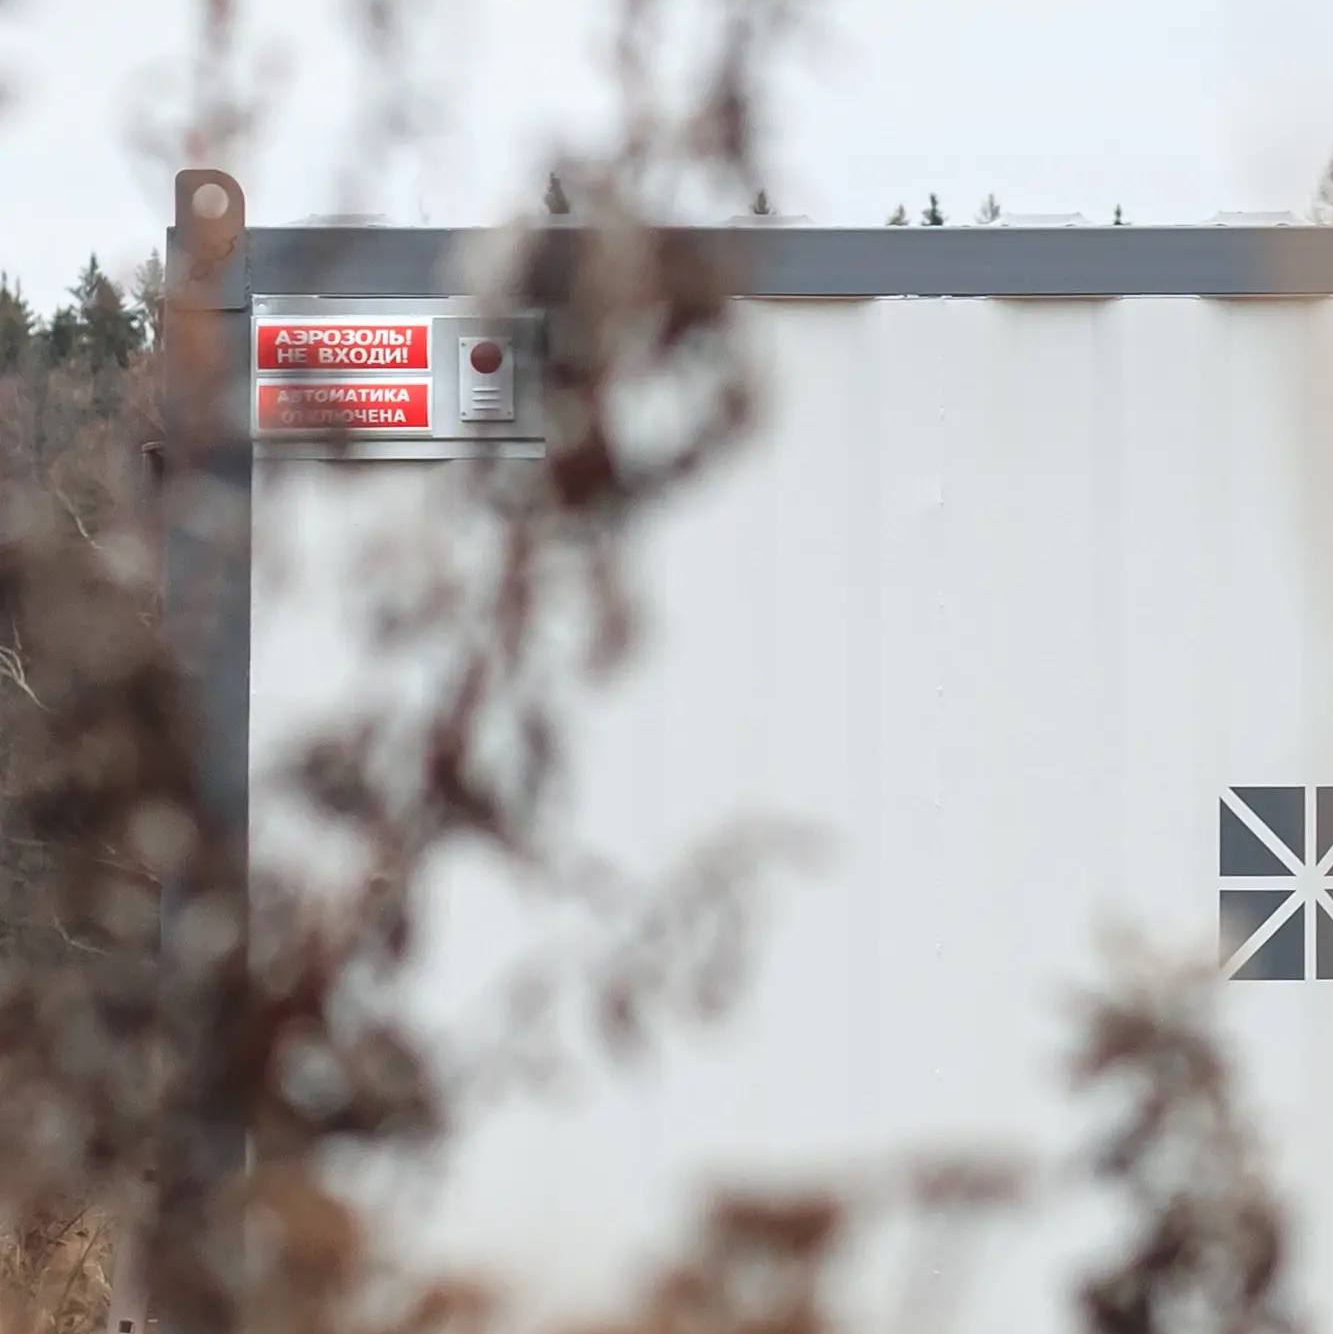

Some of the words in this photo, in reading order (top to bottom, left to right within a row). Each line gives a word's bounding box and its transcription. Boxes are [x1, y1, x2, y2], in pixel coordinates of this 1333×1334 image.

[275, 329, 412, 345] АЭРОЗОЛЬ!
[277, 348, 308, 364] НЕ
[319, 348, 408, 365] ВХОДИ!
[281, 409, 406, 424] ОТЛЮЧЕНА
